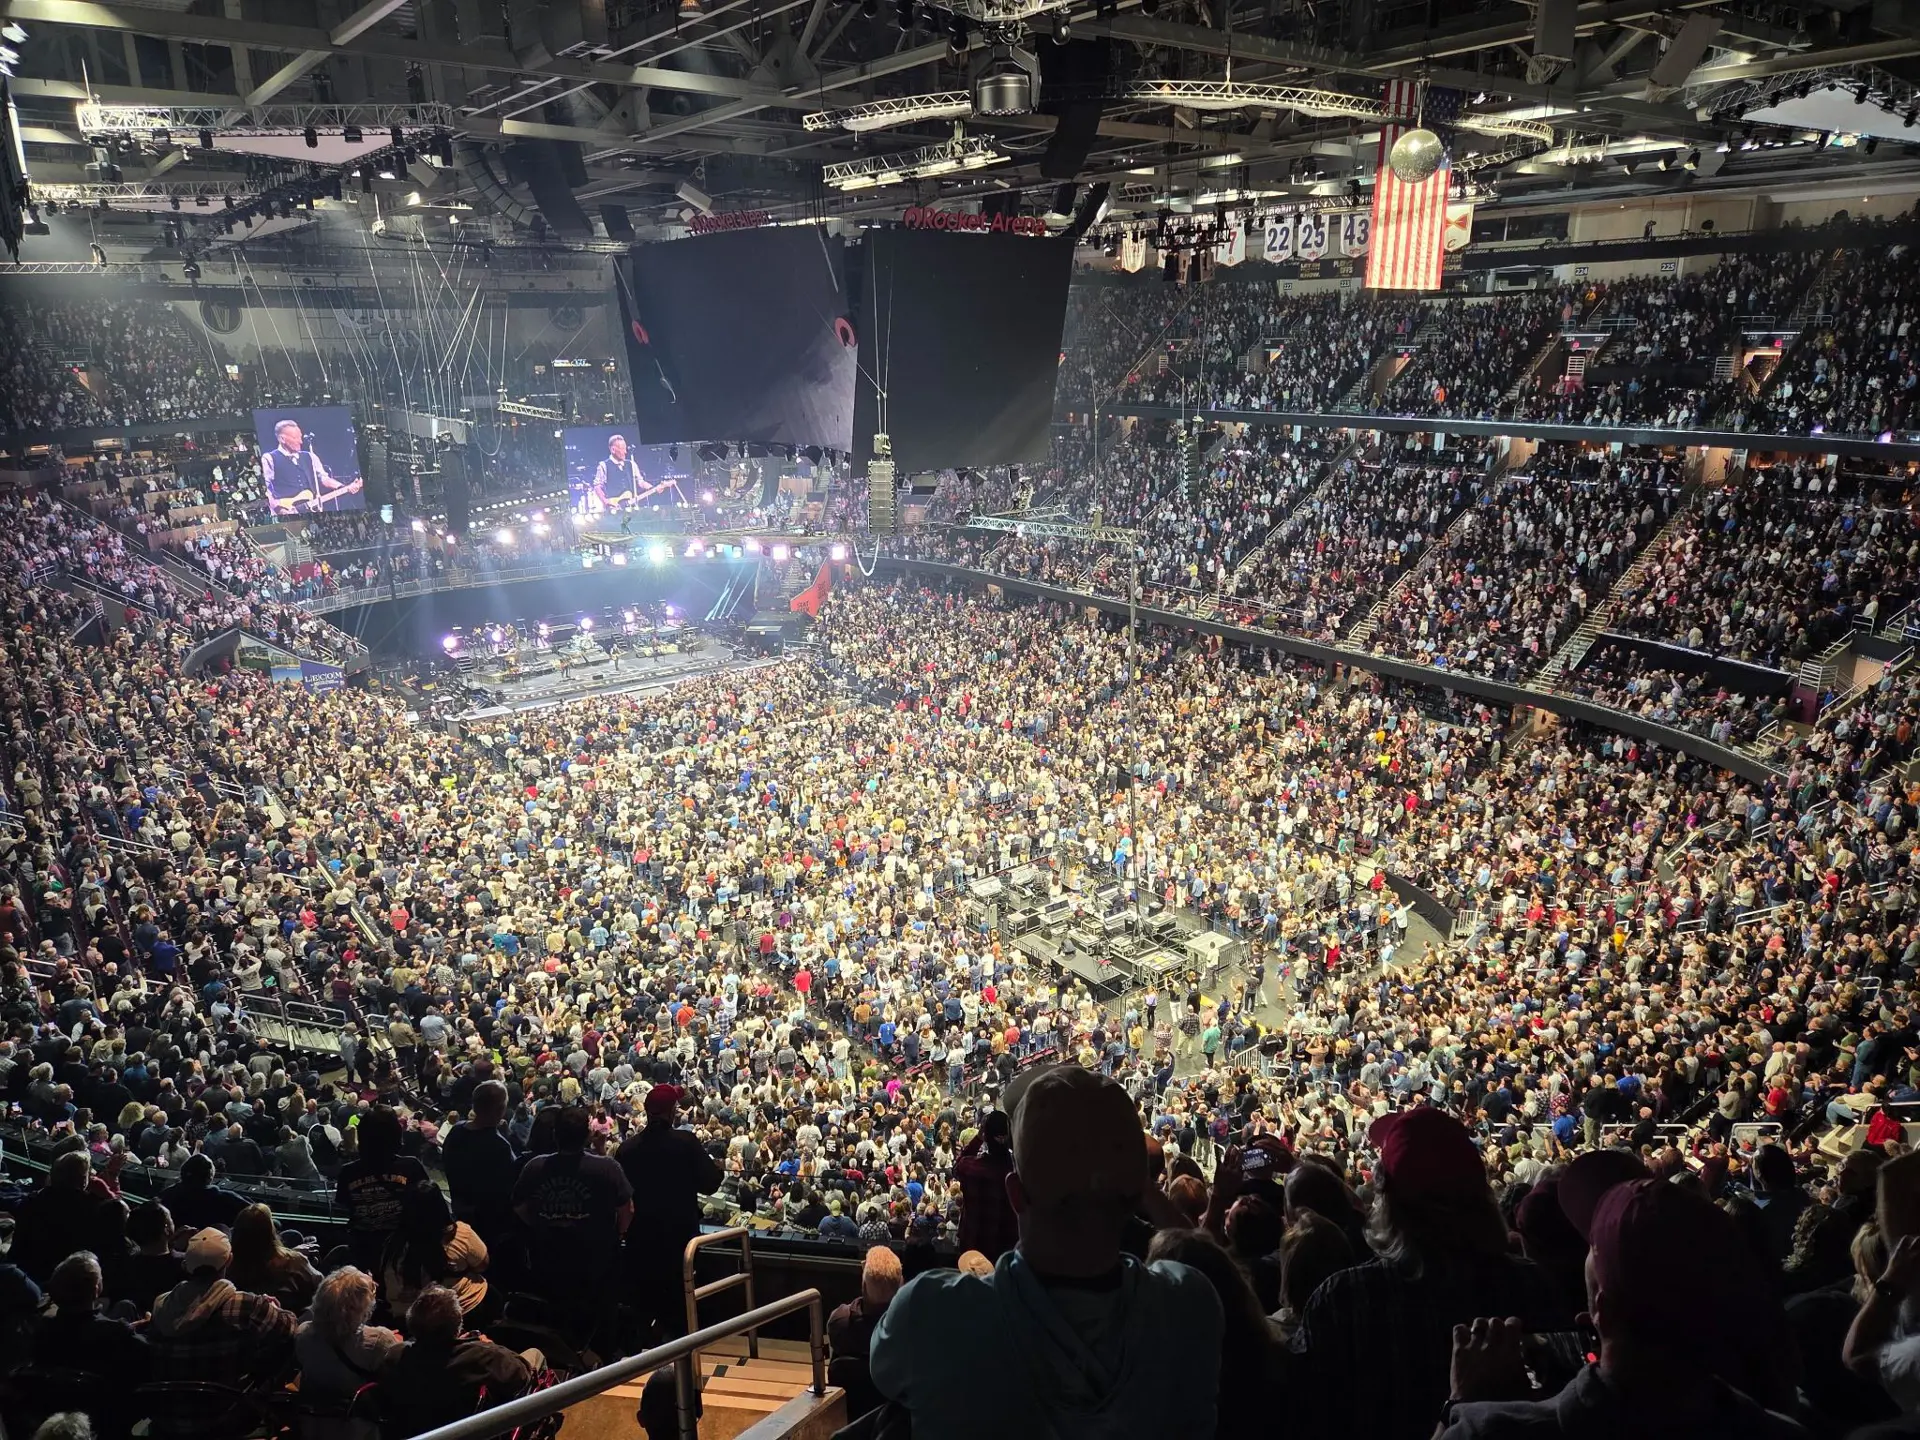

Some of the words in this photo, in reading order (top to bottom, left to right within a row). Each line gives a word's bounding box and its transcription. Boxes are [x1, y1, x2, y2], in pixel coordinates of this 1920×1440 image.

[922, 207, 988, 230] Rocket
[990, 211, 1047, 235] Arena
[1344, 214, 1369, 246] 43
[1267, 226, 1290, 252] 22
[1301, 223, 1326, 249] 25
[1575, 267, 1588, 275] 224
[1661, 263, 1675, 271] 225
